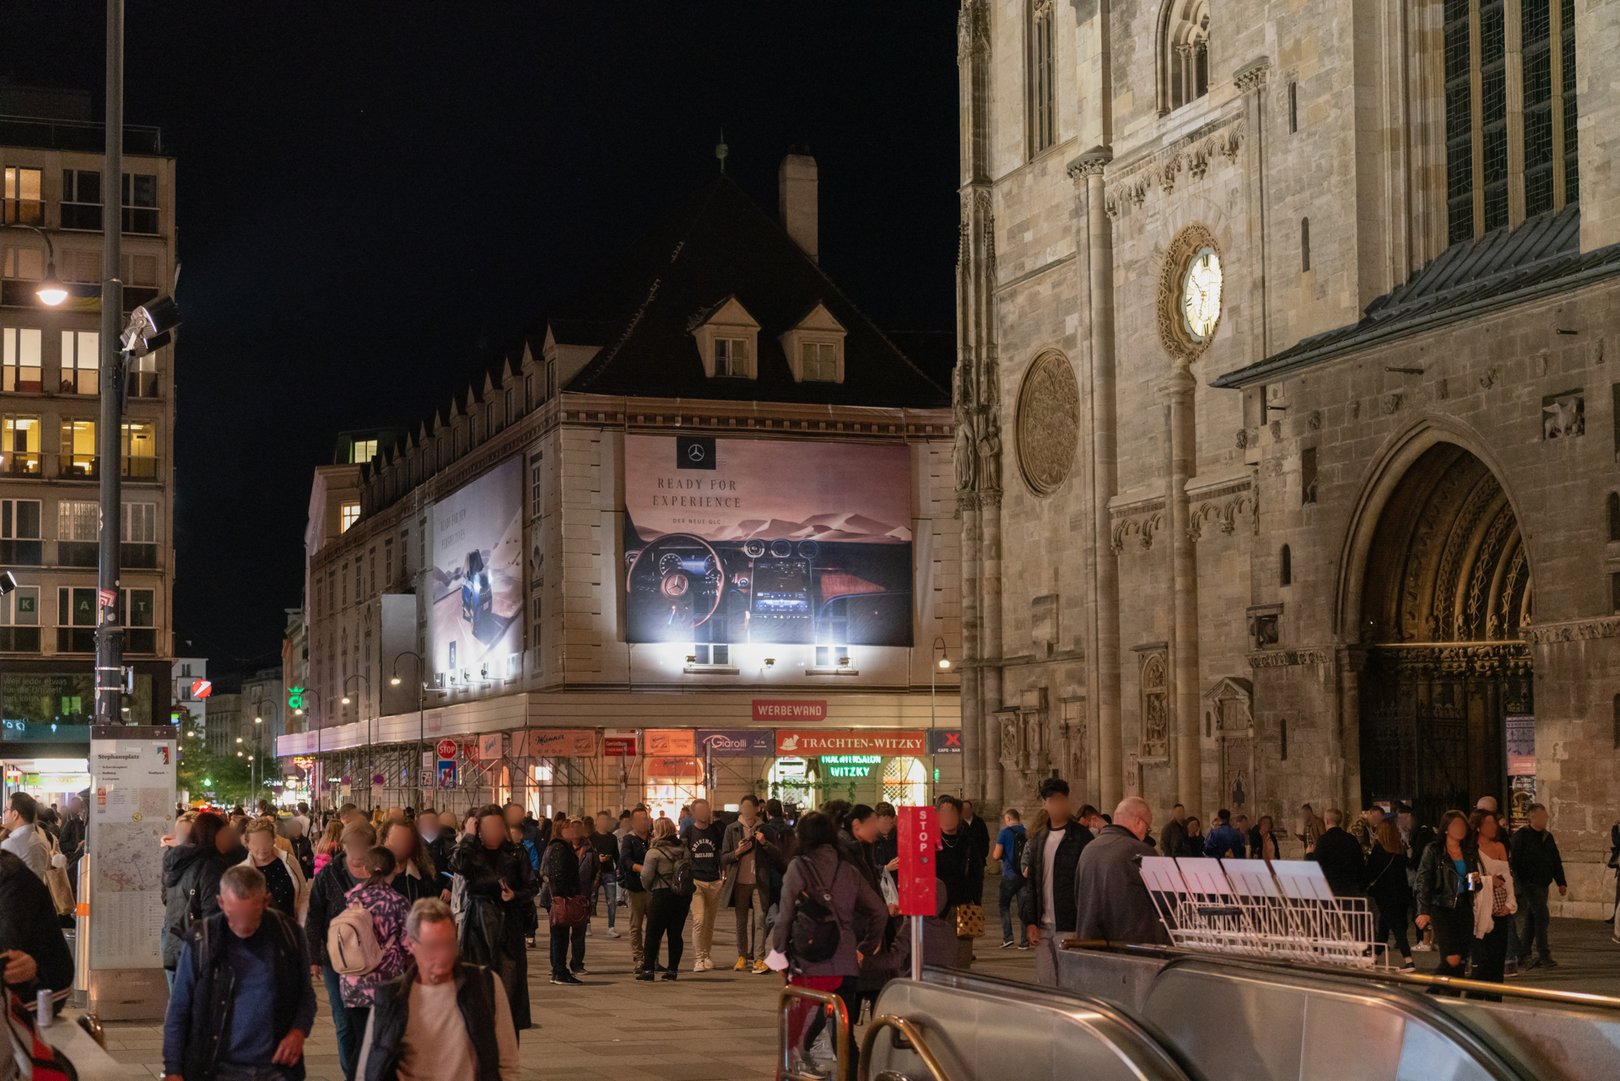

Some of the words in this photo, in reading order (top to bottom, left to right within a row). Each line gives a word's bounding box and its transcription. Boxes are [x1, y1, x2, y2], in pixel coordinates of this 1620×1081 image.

[657, 478, 702, 490] READY
[710, 479, 737, 491] FOR
[652, 495, 741, 508] EXPERIENCE
[79, 601, 90, 610] A
[138, 602, 146, 611] T
[757, 705, 822, 716] WERBEWAND
[711, 735, 747, 748] Giarolli
[801, 737, 923, 749] TRACHTEN-WITZKY
[945, 733, 960, 746] X
[439, 745, 456, 754] STOP
[830, 766, 870, 777] WITZKY
[919, 810, 928, 853] STOP
